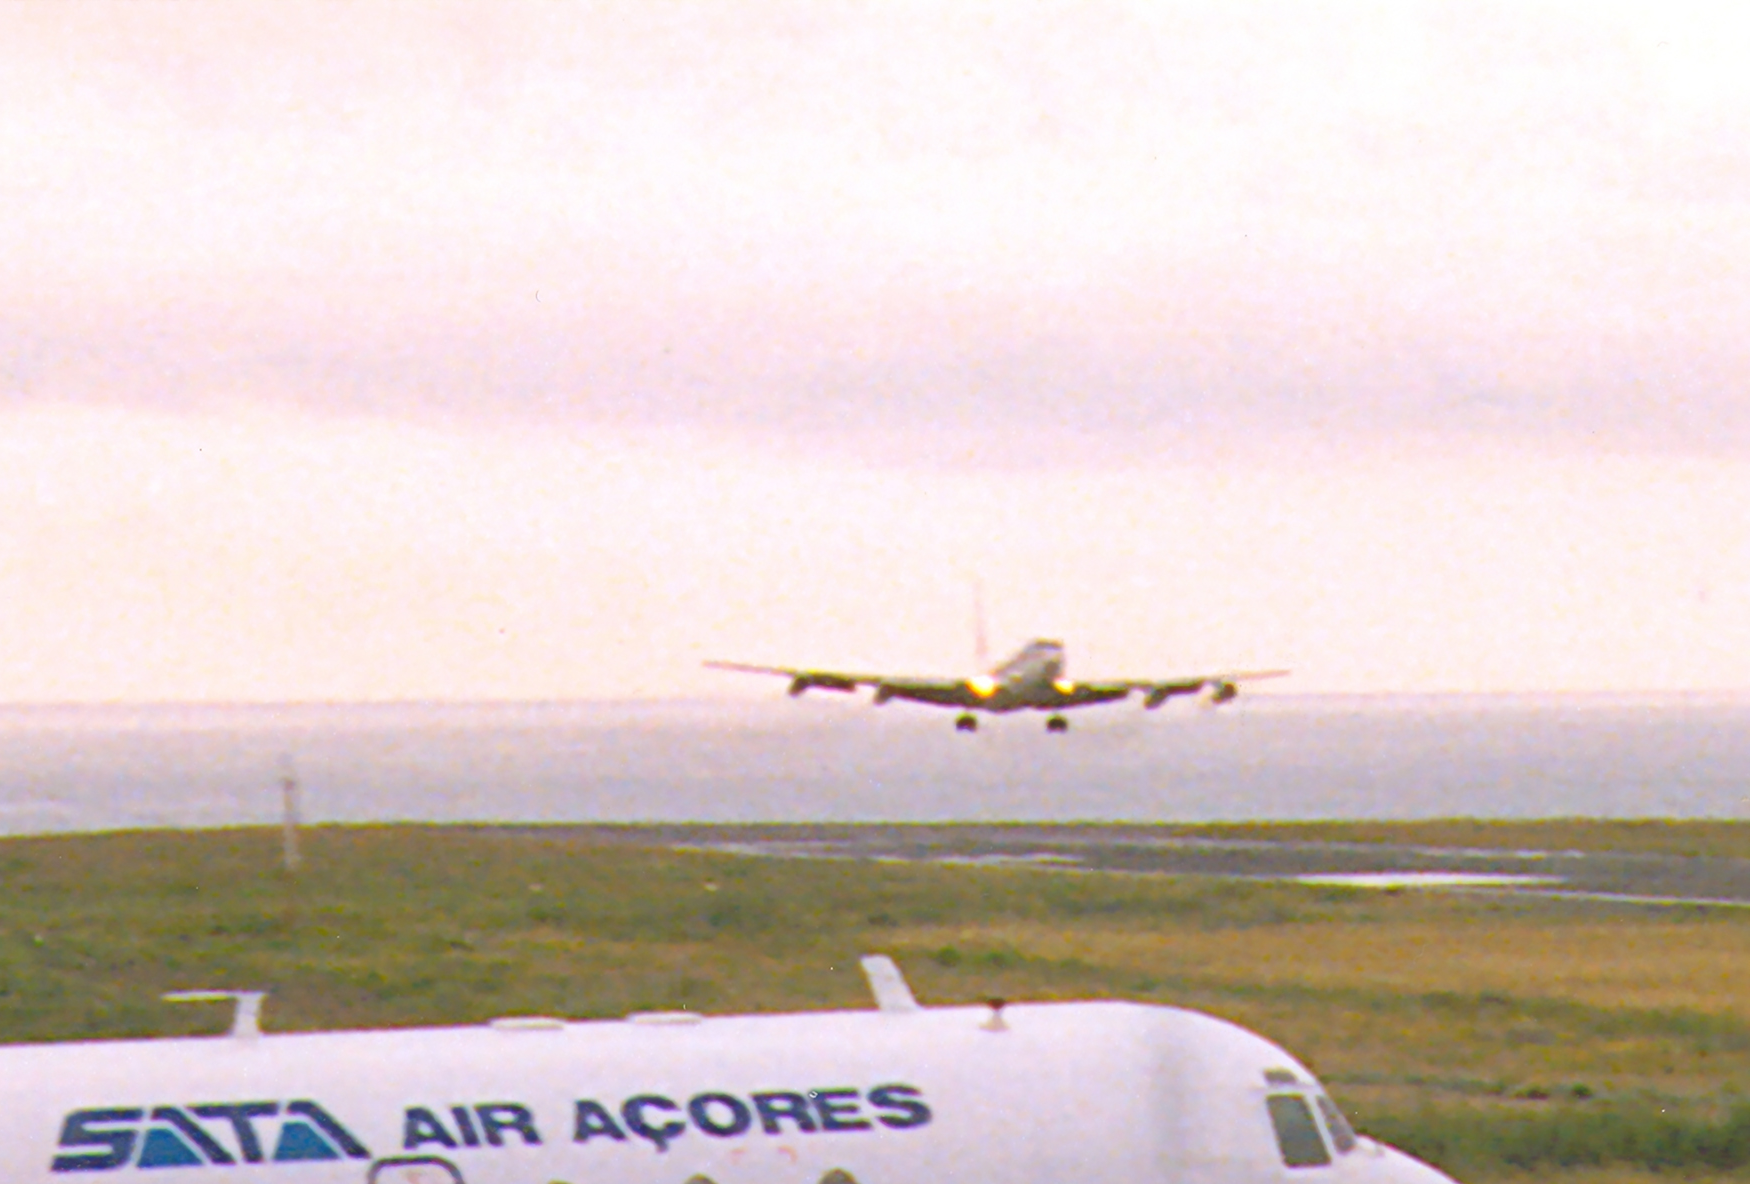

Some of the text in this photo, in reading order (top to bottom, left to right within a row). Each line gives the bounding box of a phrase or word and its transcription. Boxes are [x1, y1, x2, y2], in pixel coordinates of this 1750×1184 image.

[51, 1083, 933, 1171] SATA AIR AÇORES
